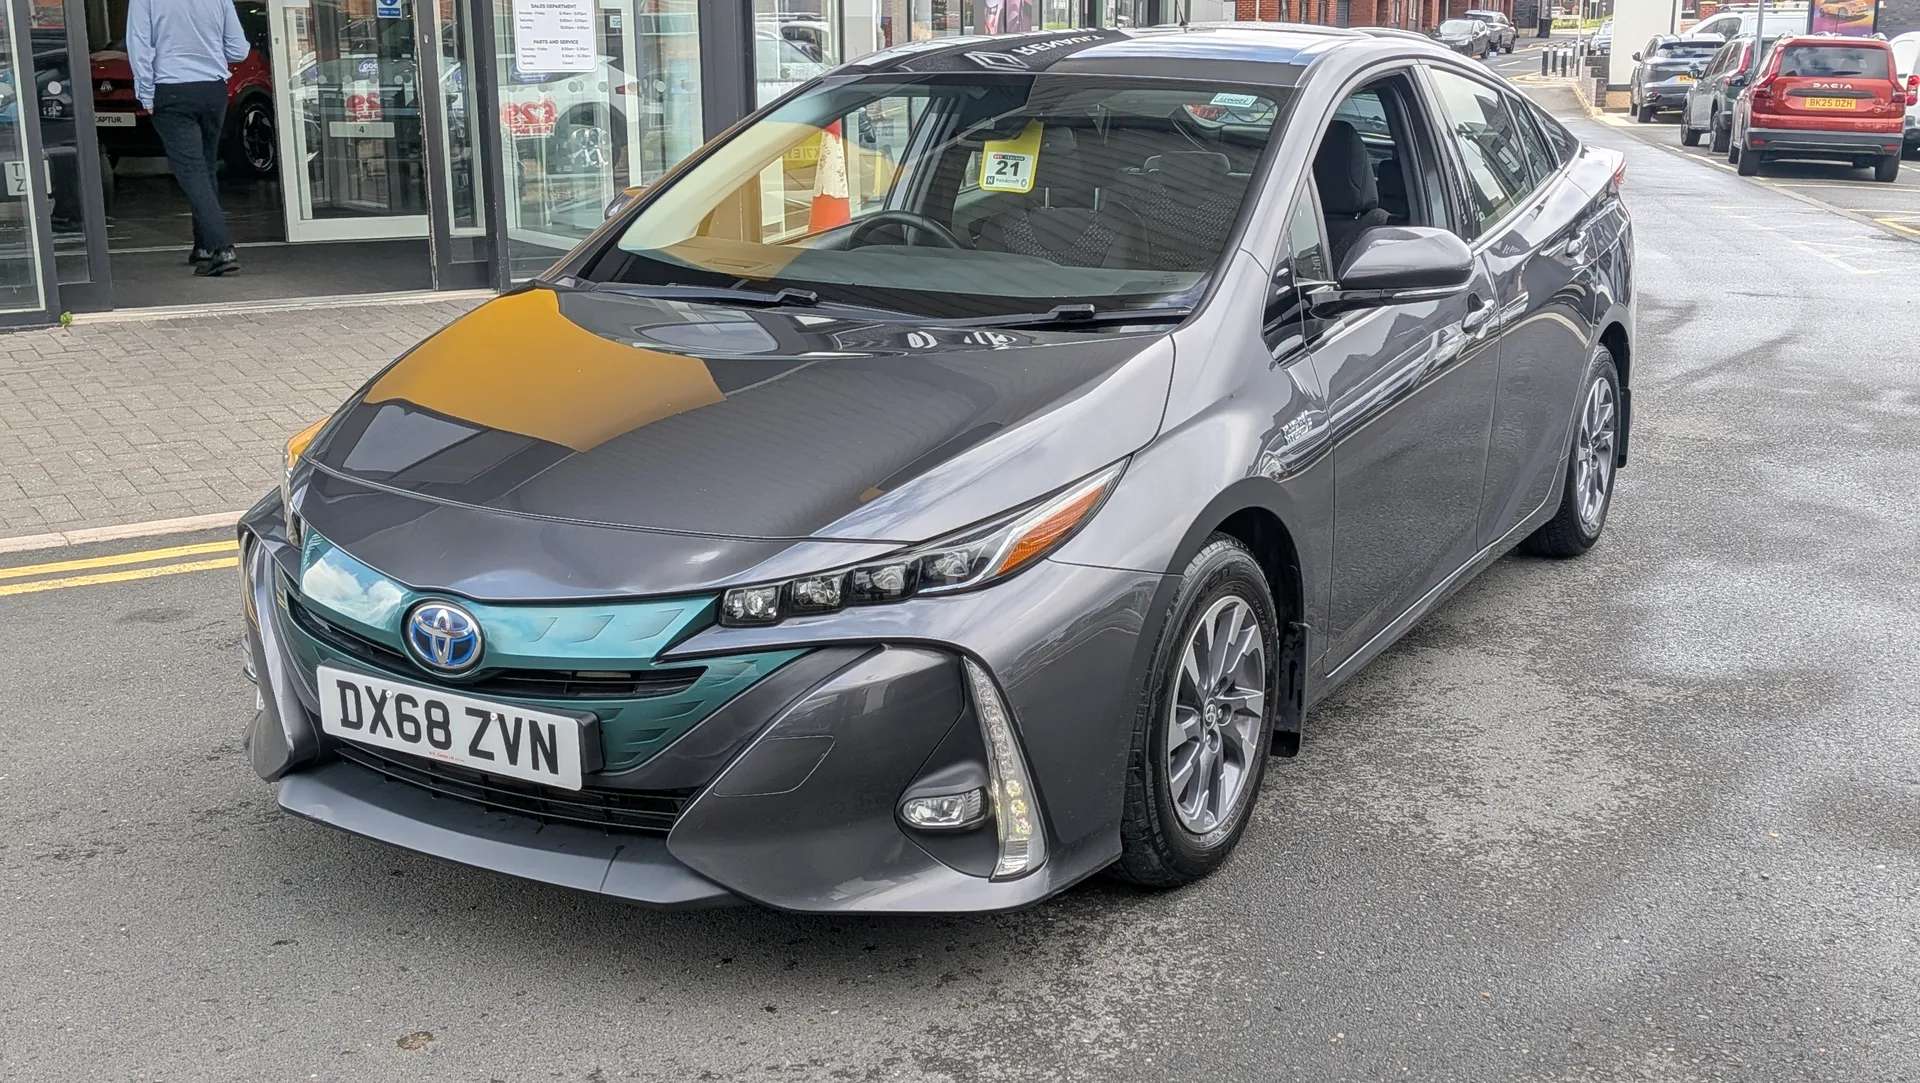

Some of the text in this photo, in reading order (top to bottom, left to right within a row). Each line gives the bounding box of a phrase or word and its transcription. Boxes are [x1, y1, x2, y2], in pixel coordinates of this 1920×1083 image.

[1809, 99, 1853, 108] BK25 DZH
[995, 160, 1020, 177] 21
[335, 679, 559, 775] DX68 ZVN
